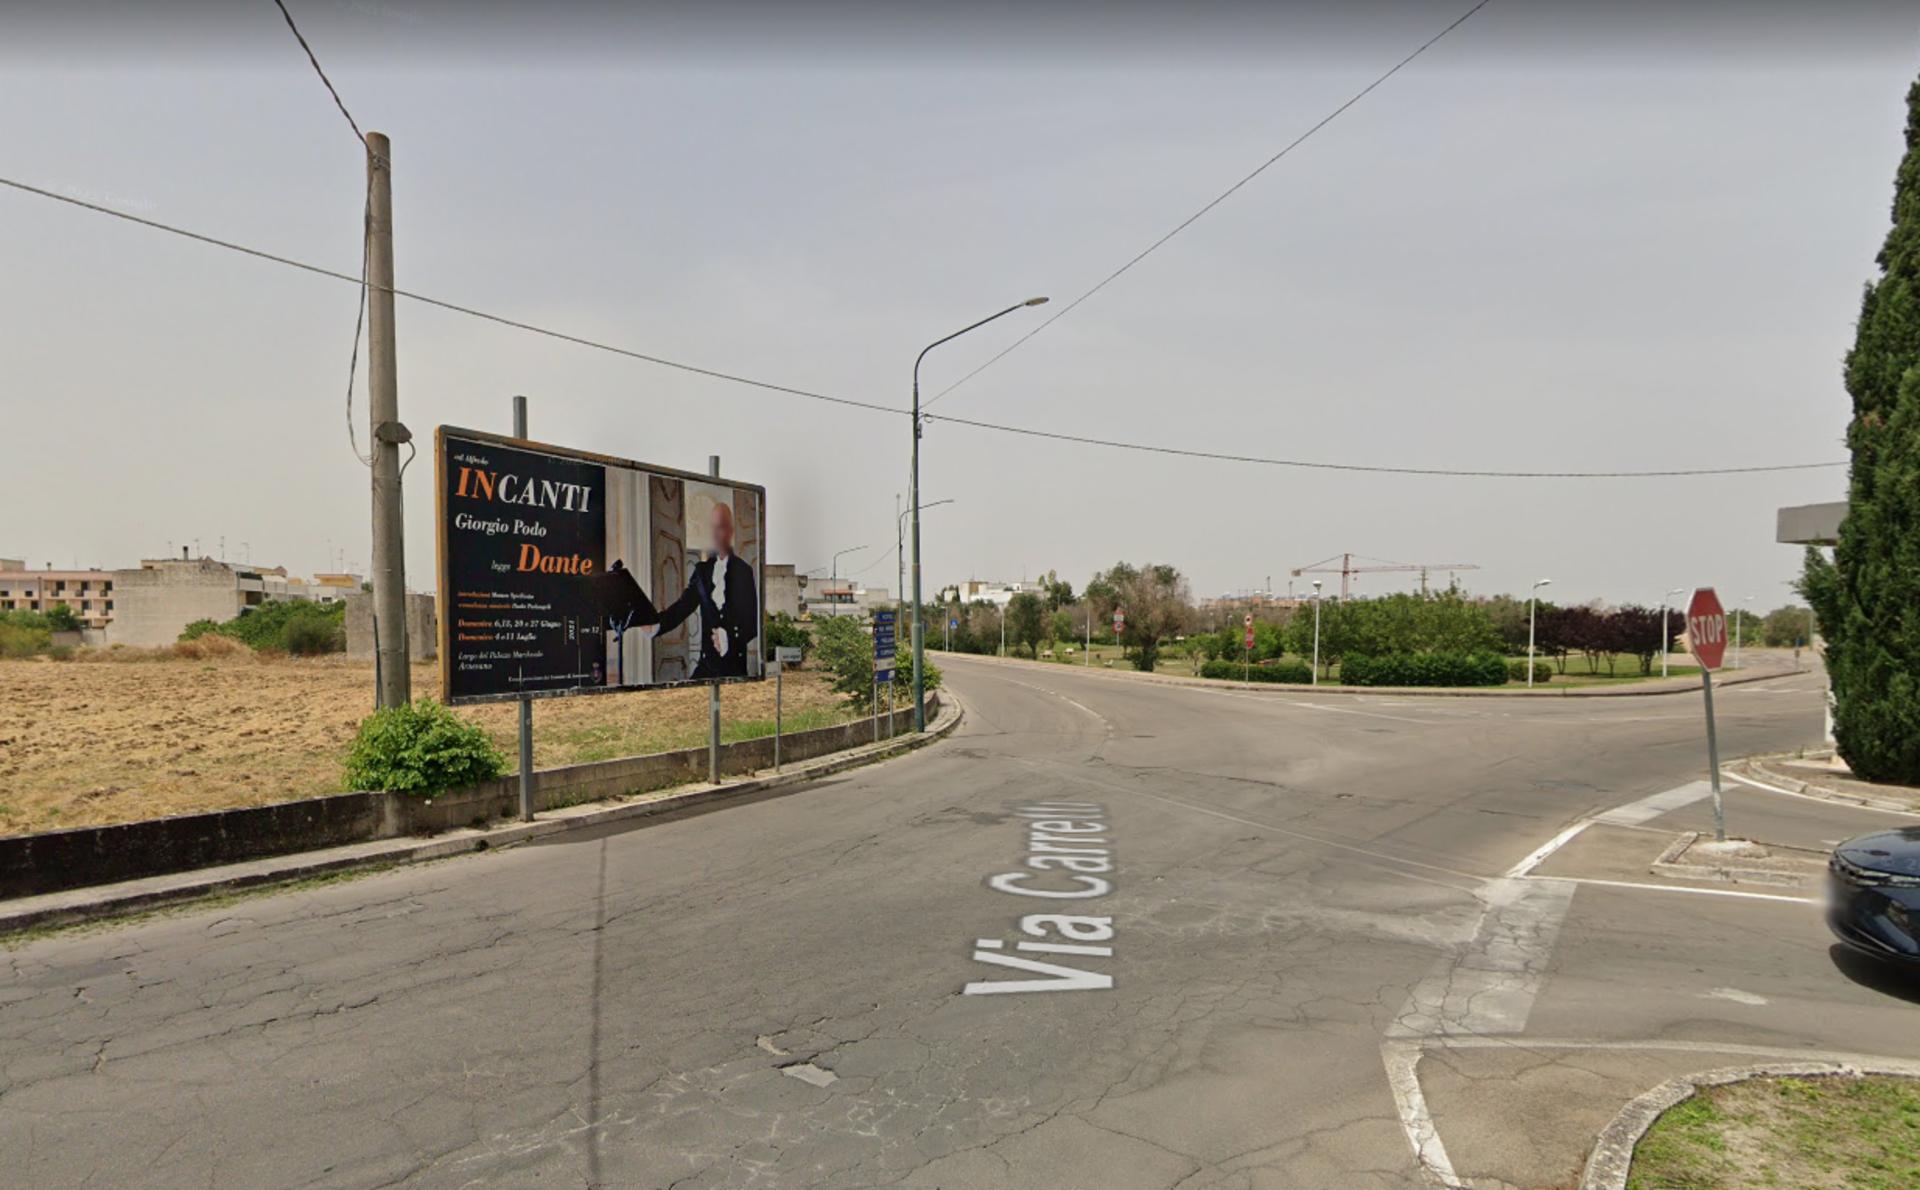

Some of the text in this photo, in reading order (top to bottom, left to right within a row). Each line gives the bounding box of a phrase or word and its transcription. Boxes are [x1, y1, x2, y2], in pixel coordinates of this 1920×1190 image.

[454, 466, 592, 513] INCANTI
[455, 512, 548, 537] Giorgio Podo
[516, 543, 593, 577] Dante
[1691, 613, 1724, 646] STOP
